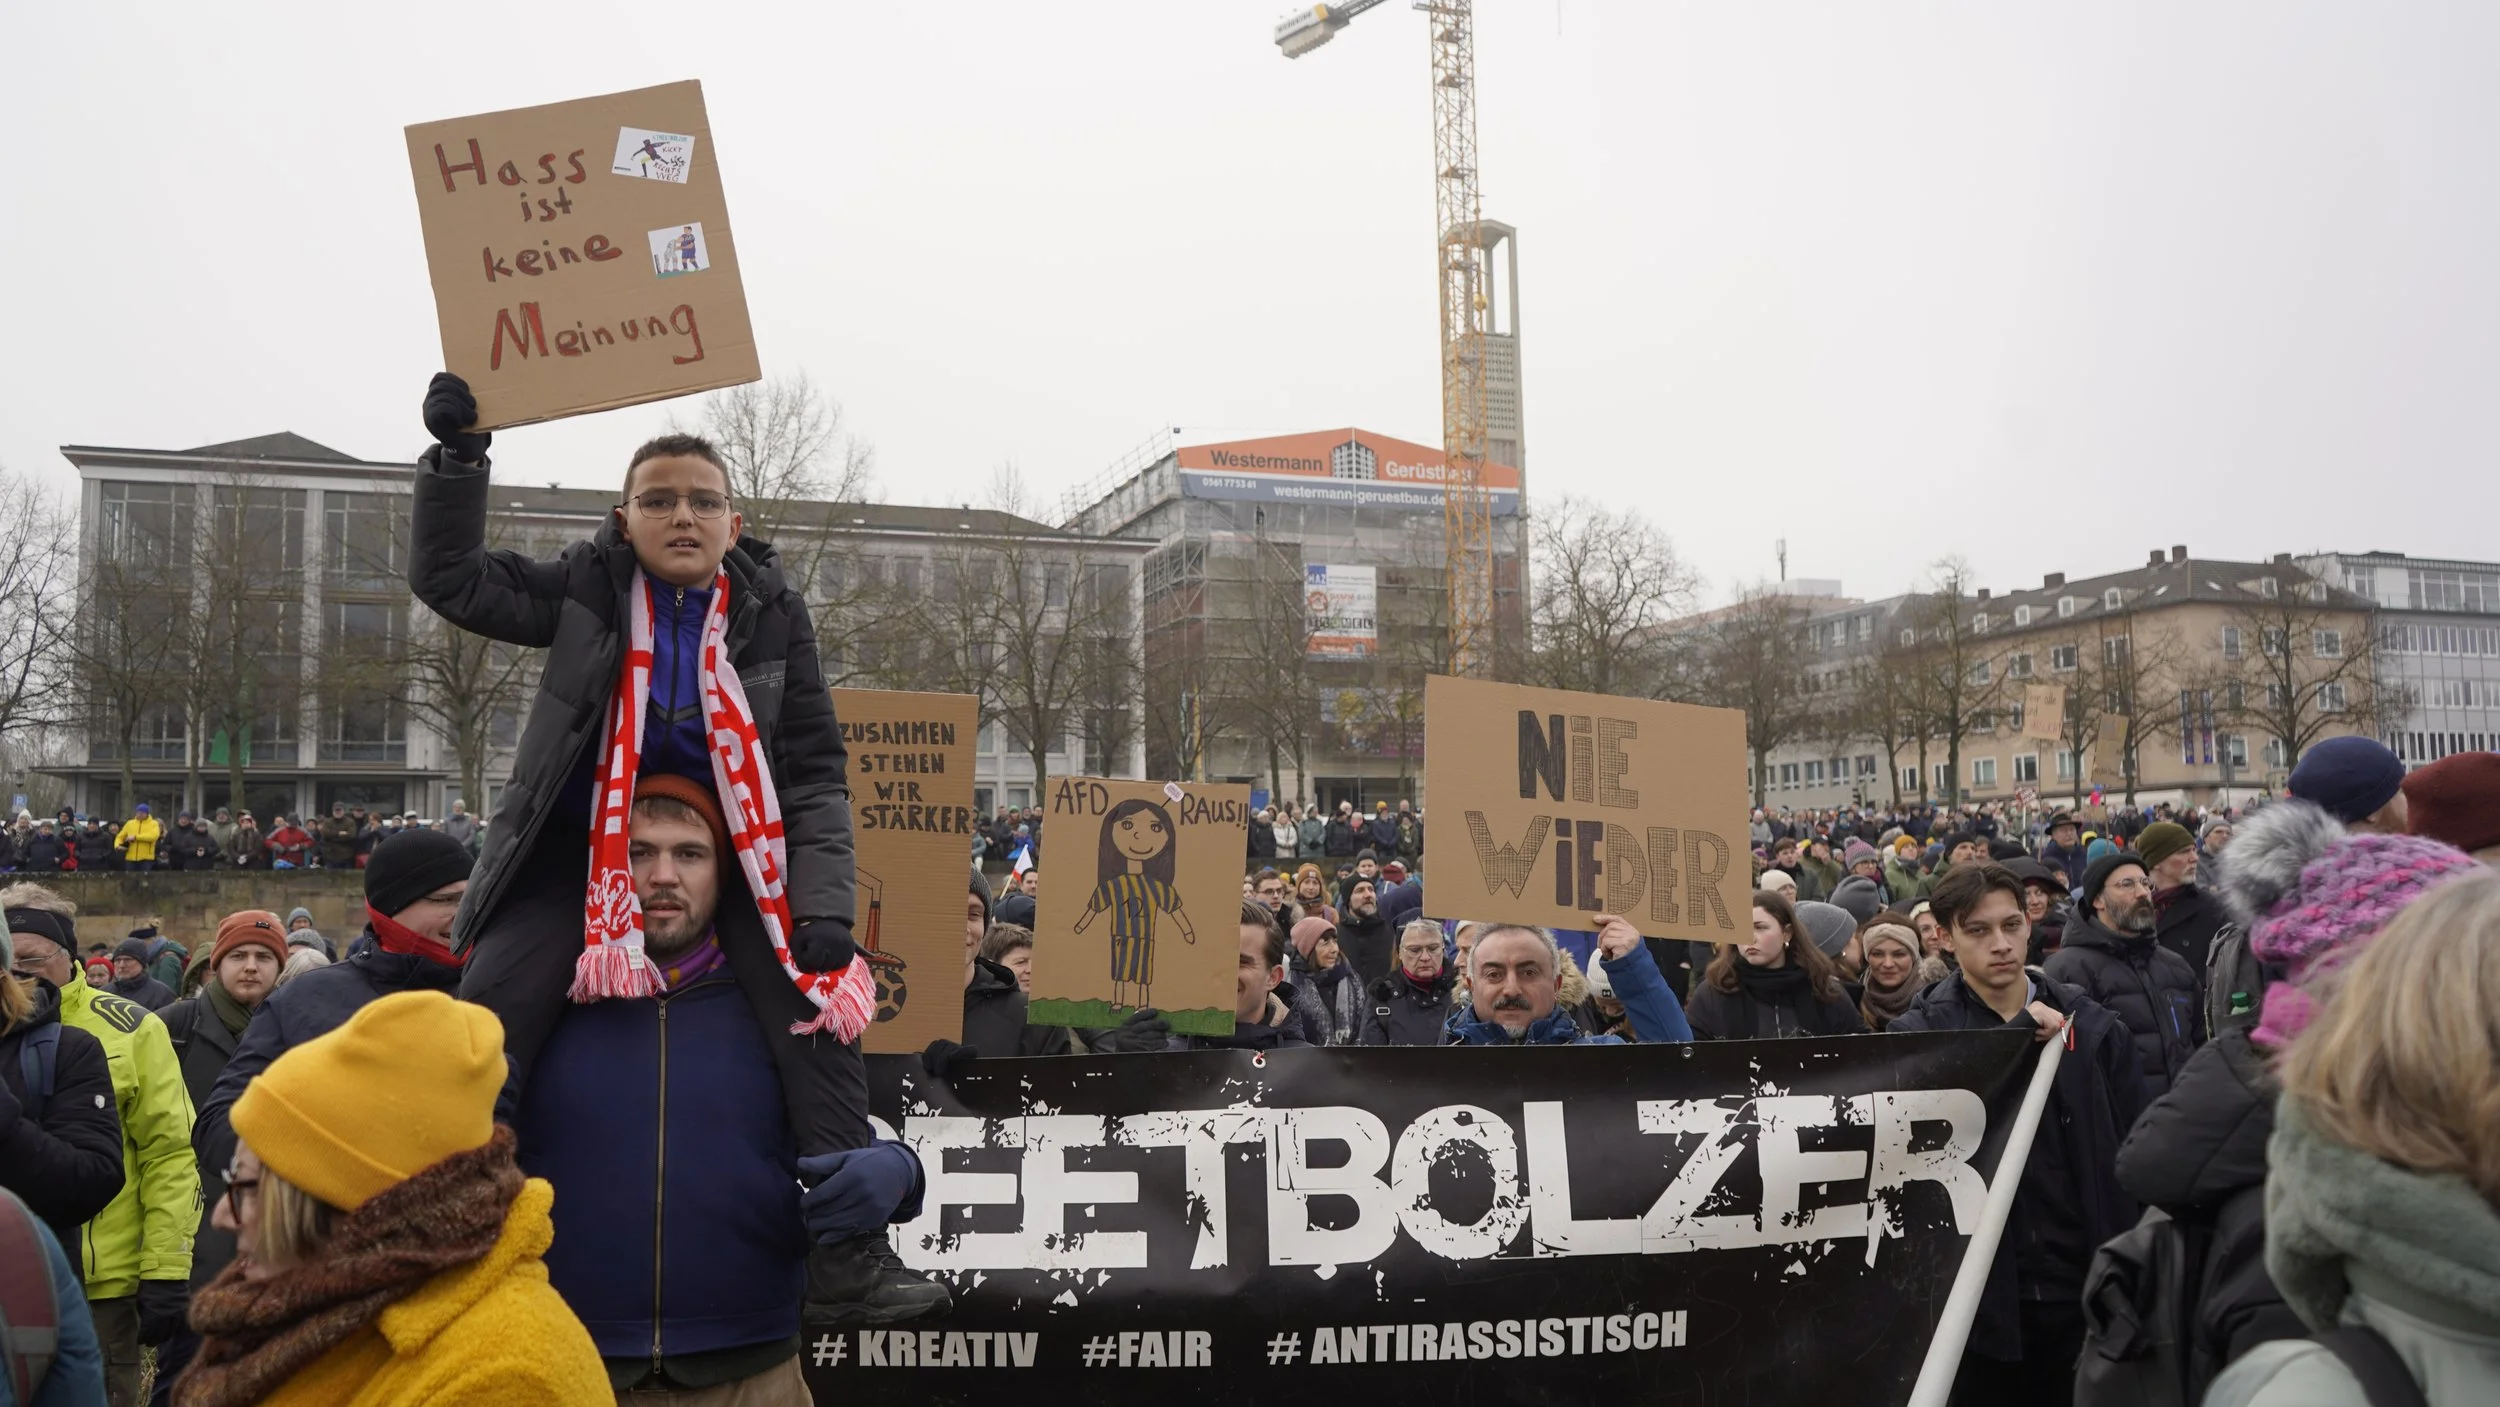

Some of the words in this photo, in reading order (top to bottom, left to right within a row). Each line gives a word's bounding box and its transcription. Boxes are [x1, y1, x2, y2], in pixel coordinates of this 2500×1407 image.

[434, 138, 587, 192] Hass
[520, 186, 573, 222] ist
[483, 234, 623, 282] keine
[490, 302, 704, 371] Meinung
[1210, 449, 1324, 472] Westermann
[1202, 477, 1223, 488] 0561
[1273, 485, 1446, 506] westermann-geruestbau.de
[840, 721, 955, 745] ZUSAMMEN
[860, 753, 944, 774] STEHEN
[1055, 778, 1109, 816] AFD
[860, 804, 970, 834] STÄRKER
[1122, 897, 1145, 918] 12
[867, 1087, 1988, 1269] EETBOLZER
[812, 1333, 847, 1367] #
[859, 1330, 1039, 1367] KREATIV
[1082, 1331, 1212, 1367] #FAIR
[1267, 1332, 1301, 1365] #
[1310, 1310, 1688, 1364] ANTIRASSISTISCH
